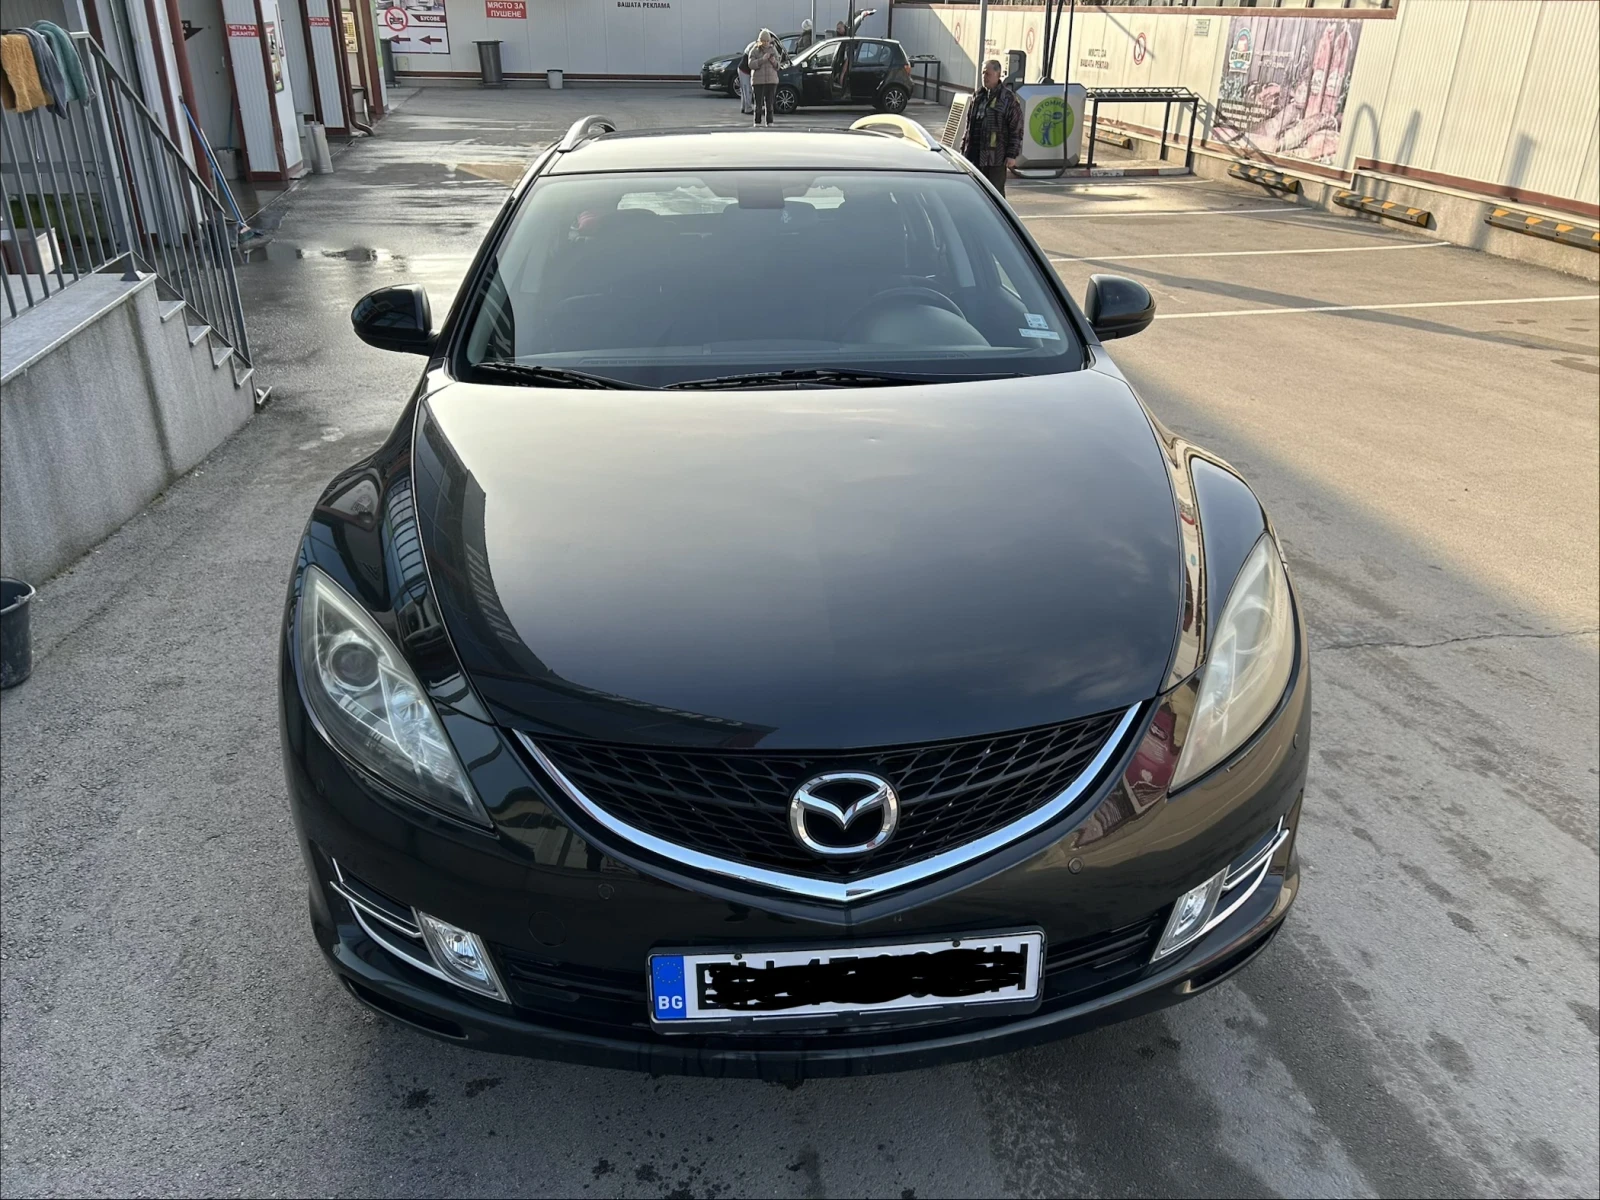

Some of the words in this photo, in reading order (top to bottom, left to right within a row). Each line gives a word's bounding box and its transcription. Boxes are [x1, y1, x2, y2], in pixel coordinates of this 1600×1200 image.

[487, 1, 513, 9] МЯСТО
[514, 2, 525, 10] ЗА
[490, 10, 522, 18] ПУШЕНЕ
[658, 995, 683, 1010] BG
